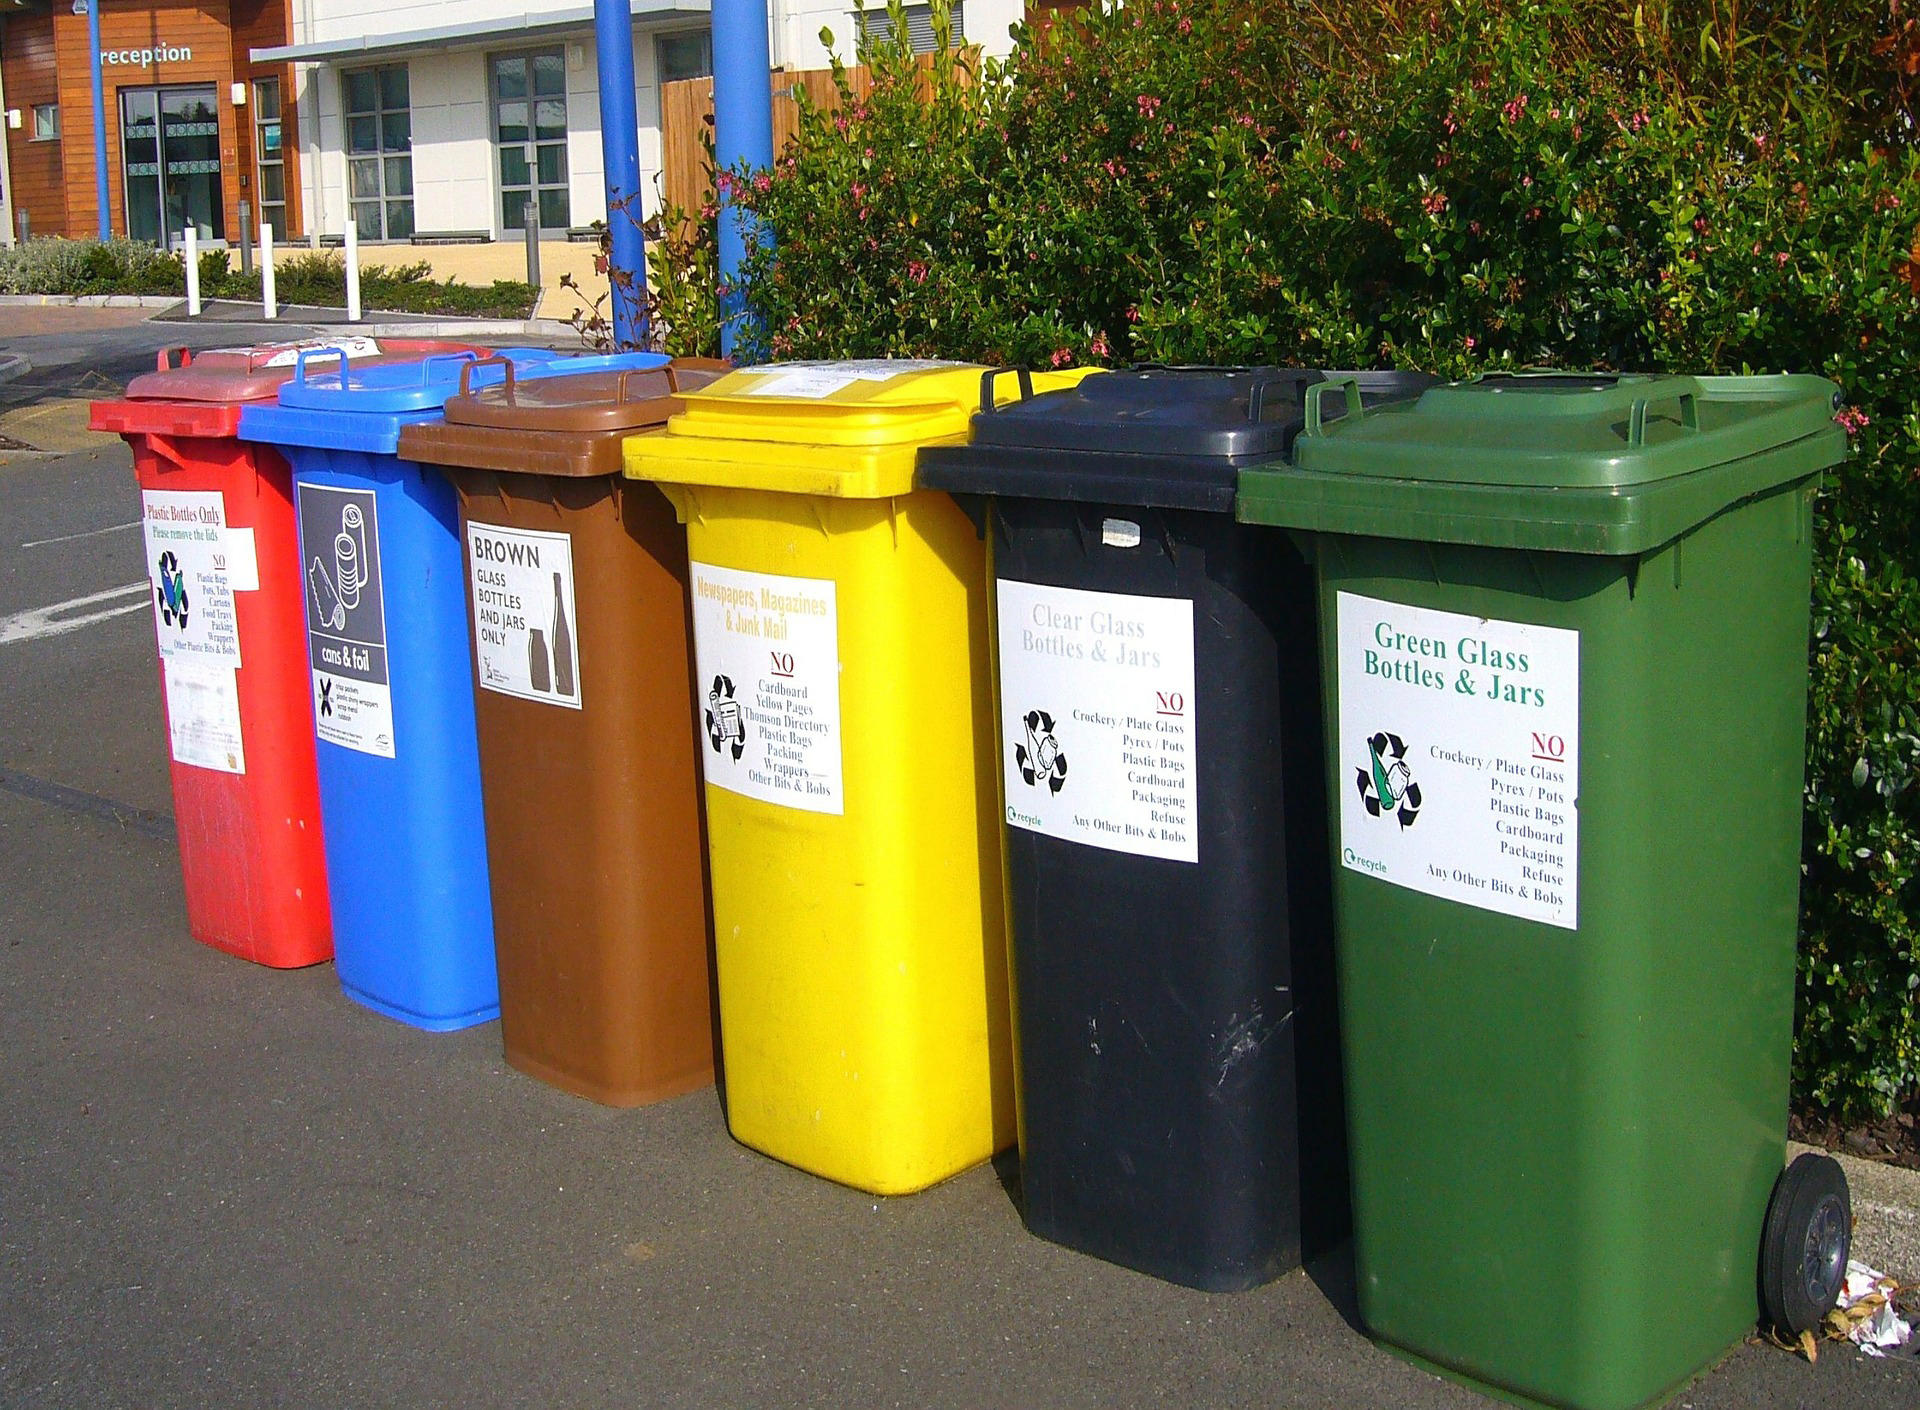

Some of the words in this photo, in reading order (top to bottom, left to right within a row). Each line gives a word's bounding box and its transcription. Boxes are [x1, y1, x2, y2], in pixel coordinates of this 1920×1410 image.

[101, 42, 191, 68] reception
[148, 505, 169, 520] Plastic
[171, 506, 197, 522] Bottles
[199, 506, 220, 526] Only
[153, 526, 169, 539] Please
[171, 530, 192, 540] remove
[194, 529, 204, 540] the
[213, 554, 225, 566] NO
[475, 536, 540, 568] BROWN
[478, 569, 506, 587] GLASS
[478, 589, 521, 609] BOTTLES
[697, 576, 758, 612] Newspapers,
[761, 588, 826, 617] Magazines
[212, 621, 233, 632] Packing
[480, 609, 499, 625] AND
[502, 614, 525, 630] JARS
[726, 610, 733, 631] &
[736, 613, 760, 636] Junk
[764, 617, 787, 640] Mail
[1033, 604, 1082, 631] Clear
[1091, 612, 1145, 639] Glass
[208, 632, 234, 646] Wrappers
[482, 629, 506, 646] ONLY
[1375, 622, 1447, 659] Green
[1457, 637, 1529, 672] Glass
[322, 648, 341, 665] cans
[343, 646, 351, 667] &
[352, 647, 369, 671] foil
[1023, 629, 1084, 659] Bottles
[1092, 640, 1107, 663] &
[1116, 643, 1161, 668] Jars
[771, 652, 793, 673] NO
[759, 679, 807, 698] Cardboard
[1364, 649, 1444, 690] Bottles
[1455, 669, 1476, 696] &
[1487, 674, 1545, 707] Jars
[757, 694, 783, 710] Yellow
[787, 700, 813, 716] Pages
[1156, 691, 1184, 711] NO
[744, 707, 781, 726] Thomson
[785, 715, 830, 736] Directory
[1073, 709, 1115, 728] Crockery
[1127, 716, 1151, 730] Plate
[1156, 720, 1184, 734] Glass
[759, 726, 787, 742] Plastic
[790, 732, 812, 748] Bags
[1123, 734, 1150, 749] Pyrex
[1163, 739, 1184, 752] Pots
[1532, 732, 1564, 757] NO
[768, 743, 803, 763] Packing
[1123, 752, 1155, 768] Plastic
[1160, 758, 1185, 771] Bags
[764, 757, 809, 778] Wrappers
[1430, 745, 1484, 770] Crockery
[1496, 758, 1526, 776] Plate
[1530, 766, 1564, 783] Glass
[749, 769, 771, 785] Other
[775, 776, 791, 790] Bits
[794, 779, 802, 792] &
[807, 781, 831, 796] Bobs
[1128, 771, 1185, 789] Cardboard
[1132, 790, 1185, 808] Packaging
[1491, 778, 1525, 797] Pyrex
[1538, 787, 1564, 804] Pots
[1017, 813, 1042, 826] recycle
[1151, 810, 1186, 825] Refuse
[1490, 798, 1530, 818] Plastic
[1535, 806, 1564, 825] Bags
[1073, 815, 1089, 829] Any
[1094, 818, 1121, 834] Other
[1125, 824, 1144, 838] Bits
[1148, 827, 1157, 839] &
[1161, 830, 1186, 843] Bobs
[1496, 820, 1563, 845] Cardboard
[1357, 856, 1387, 873] recycle
[1500, 841, 1563, 868] Packaging
[1427, 863, 1449, 881] Any
[1453, 869, 1487, 889] Other
[1491, 878, 1514, 896] Bits
[1518, 884, 1528, 898] &
[1534, 888, 1563, 906] Bobs
[1522, 865, 1563, 886] Refuse
